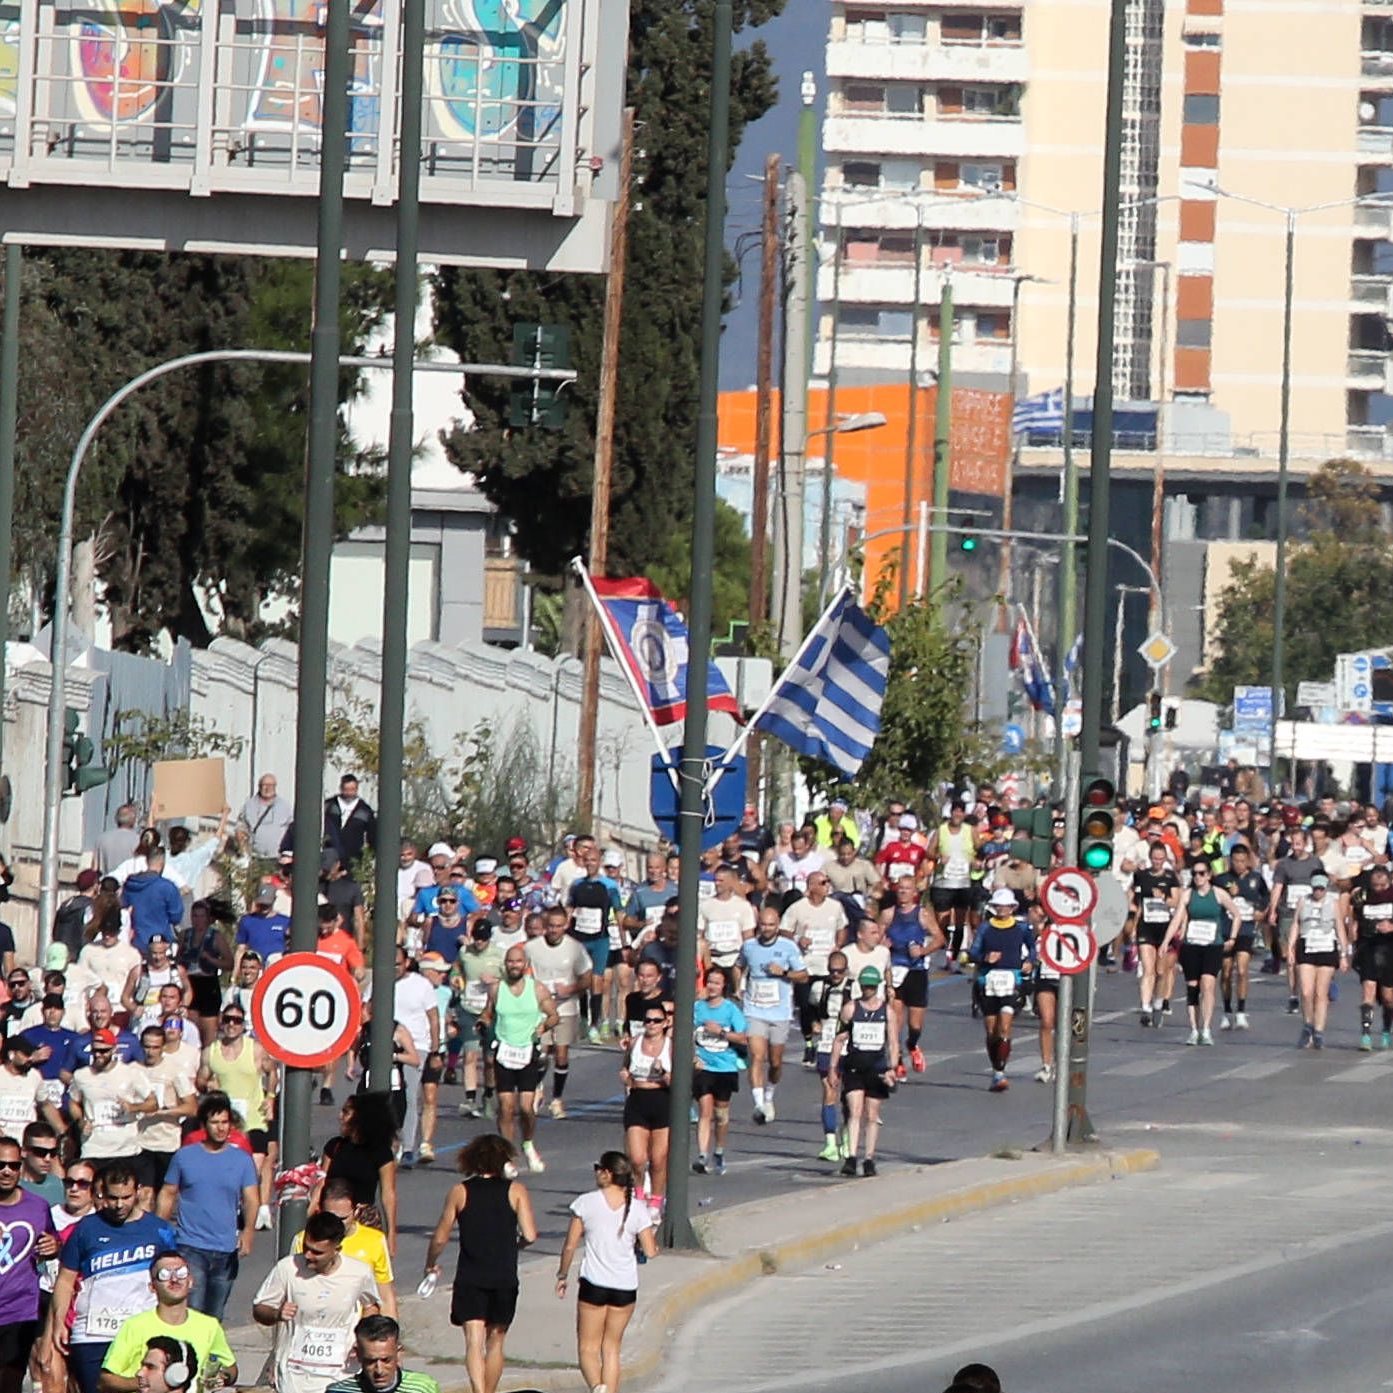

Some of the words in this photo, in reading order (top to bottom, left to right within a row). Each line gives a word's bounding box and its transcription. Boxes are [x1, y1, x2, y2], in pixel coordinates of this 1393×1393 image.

[274, 987, 336, 1031] 60
[90, 1244, 155, 1273] HELLAS
[300, 1343, 333, 1357] 4063
